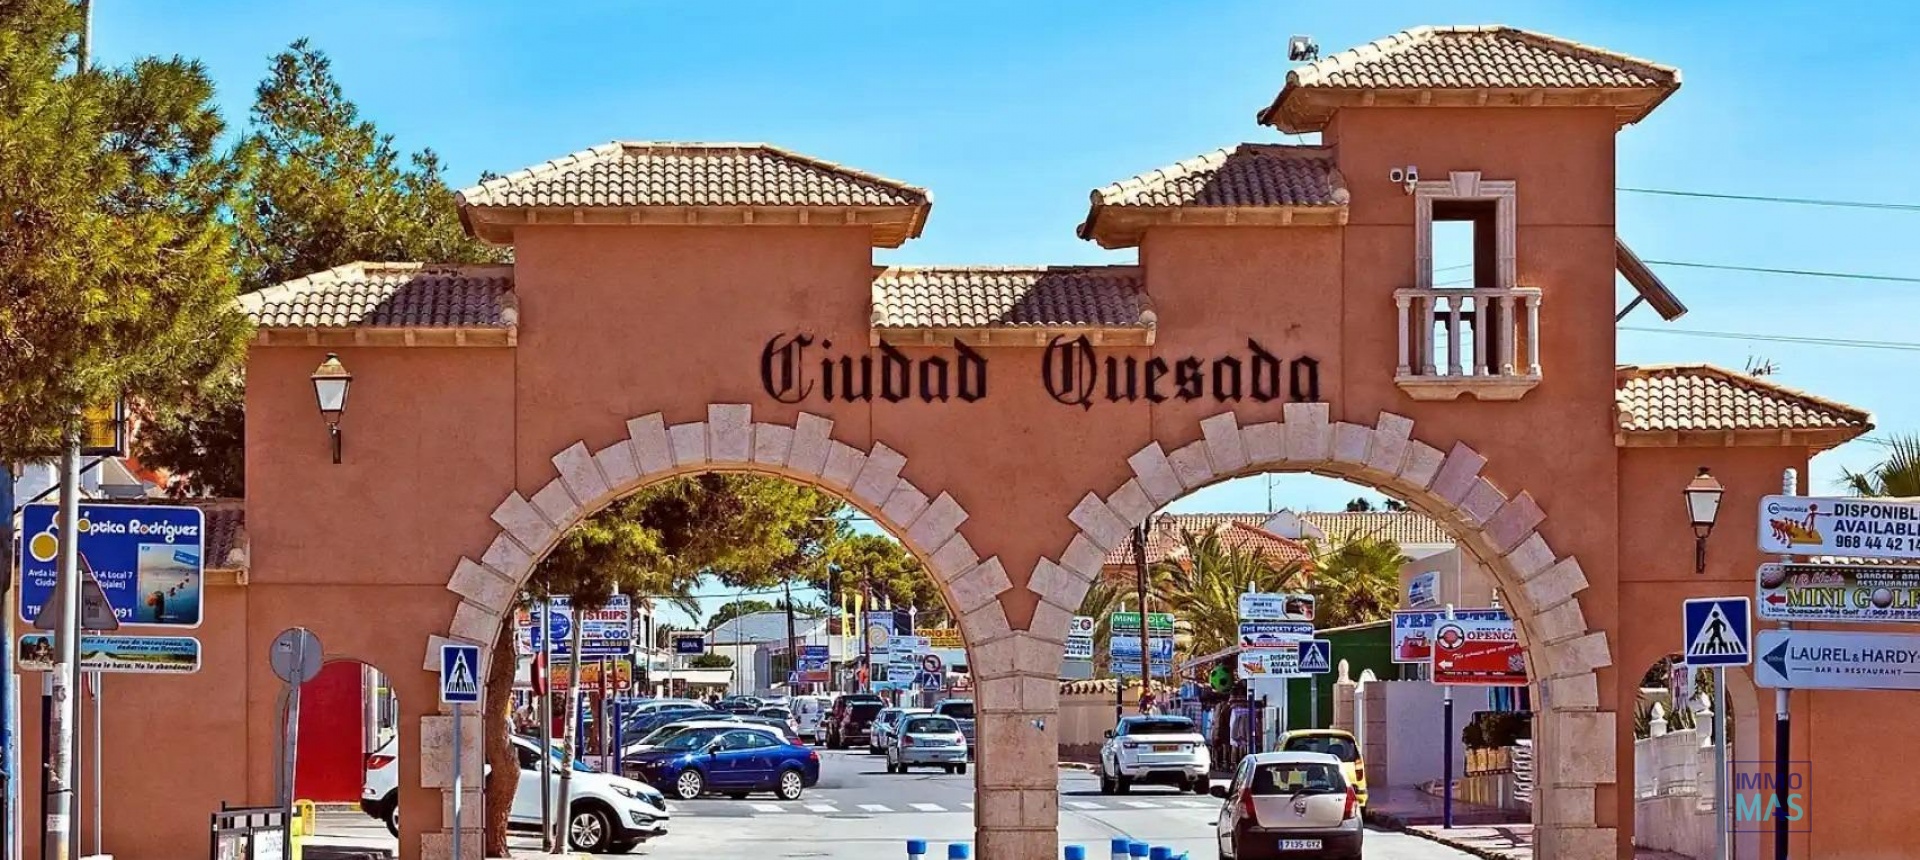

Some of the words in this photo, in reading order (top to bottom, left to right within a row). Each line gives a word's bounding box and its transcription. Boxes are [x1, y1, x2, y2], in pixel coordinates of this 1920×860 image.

[761, 332, 988, 405] Ciudad
[1042, 333, 1323, 412] Quesada
[128, 519, 198, 544] Rodríguez
[1836, 535, 1860, 548] 968
[1865, 536, 1882, 550] 44
[1886, 537, 1902, 551] 42
[108, 571, 125, 579] Local
[1785, 587, 1846, 607] MINI
[1791, 646, 1851, 662] LAUREL
[1852, 653, 1860, 662] &
[1862, 649, 1918, 664] HARDY
[1845, 667, 1902, 676] RESTAURANT
